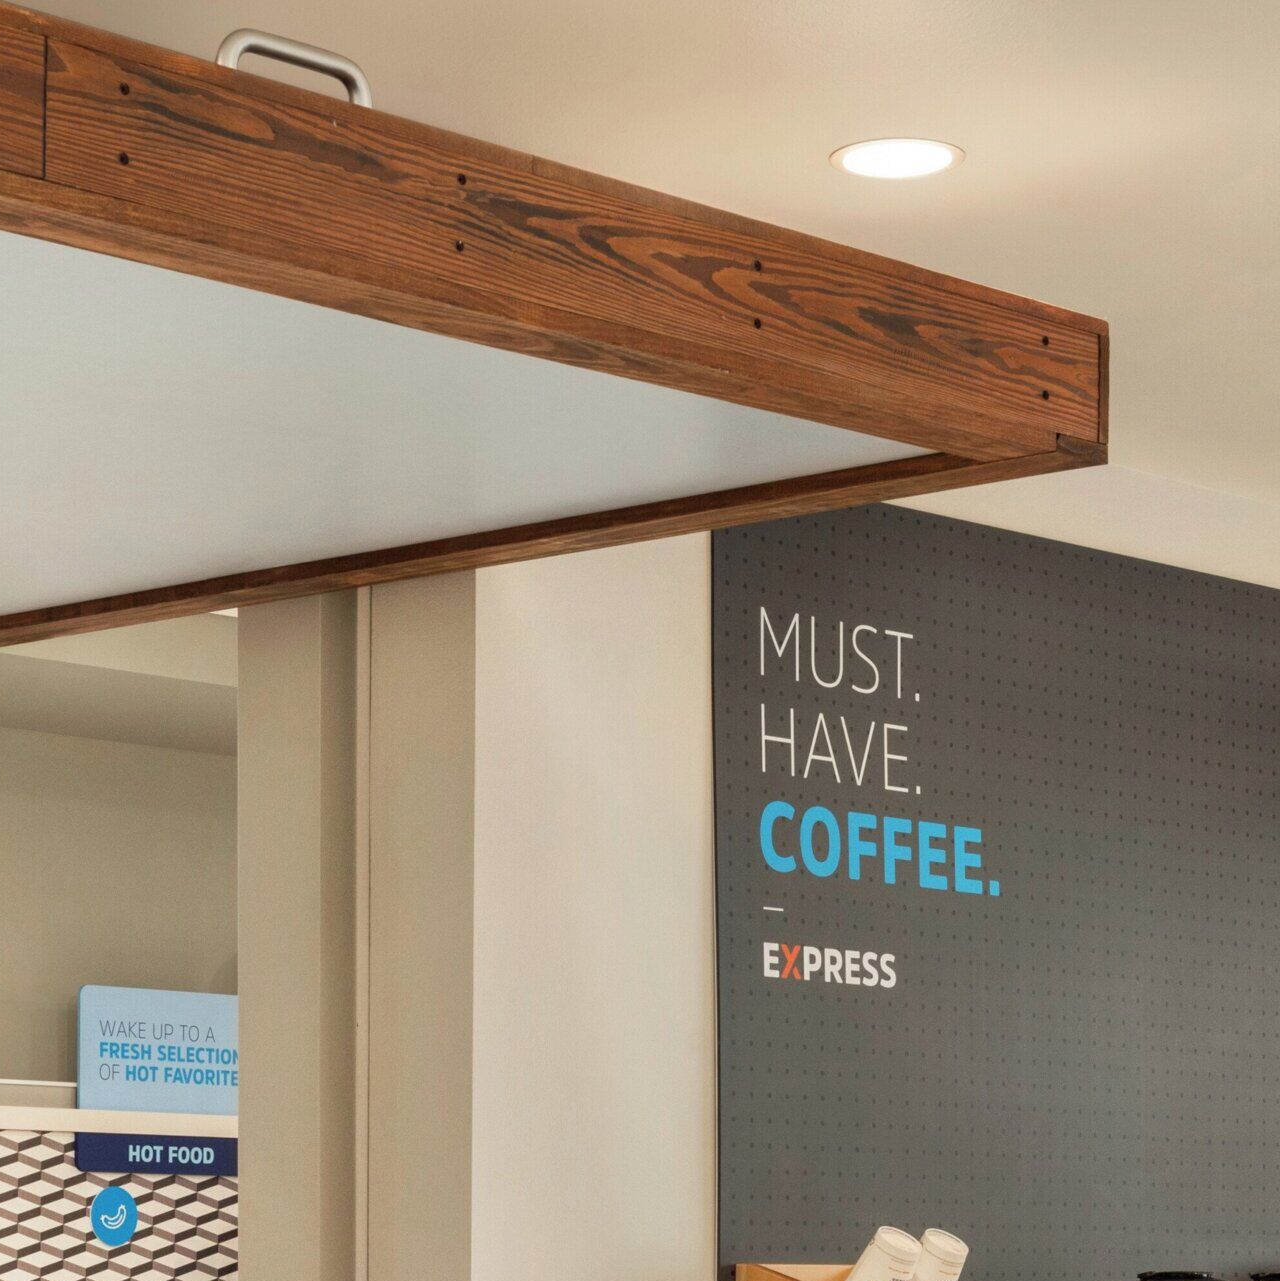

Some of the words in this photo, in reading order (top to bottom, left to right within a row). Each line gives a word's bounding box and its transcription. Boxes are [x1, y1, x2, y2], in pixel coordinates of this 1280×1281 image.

[760, 606, 920, 702] MUST.
[760, 703, 921, 795] HAVE.
[760, 800, 1000, 897] COFFEE.
[763, 942, 897, 988] EXPRESS
[99, 1019, 147, 1039] WAKE
[152, 1023, 174, 1040] UP
[180, 1025, 200, 1042] TO
[205, 1027, 216, 1043] A
[99, 1042, 152, 1061] FRESH
[99, 1063, 120, 1081] OF
[125, 1065, 159, 1082] HOT
[128, 1145, 163, 1163] HOT
[168, 1146, 215, 1164] FOOD
